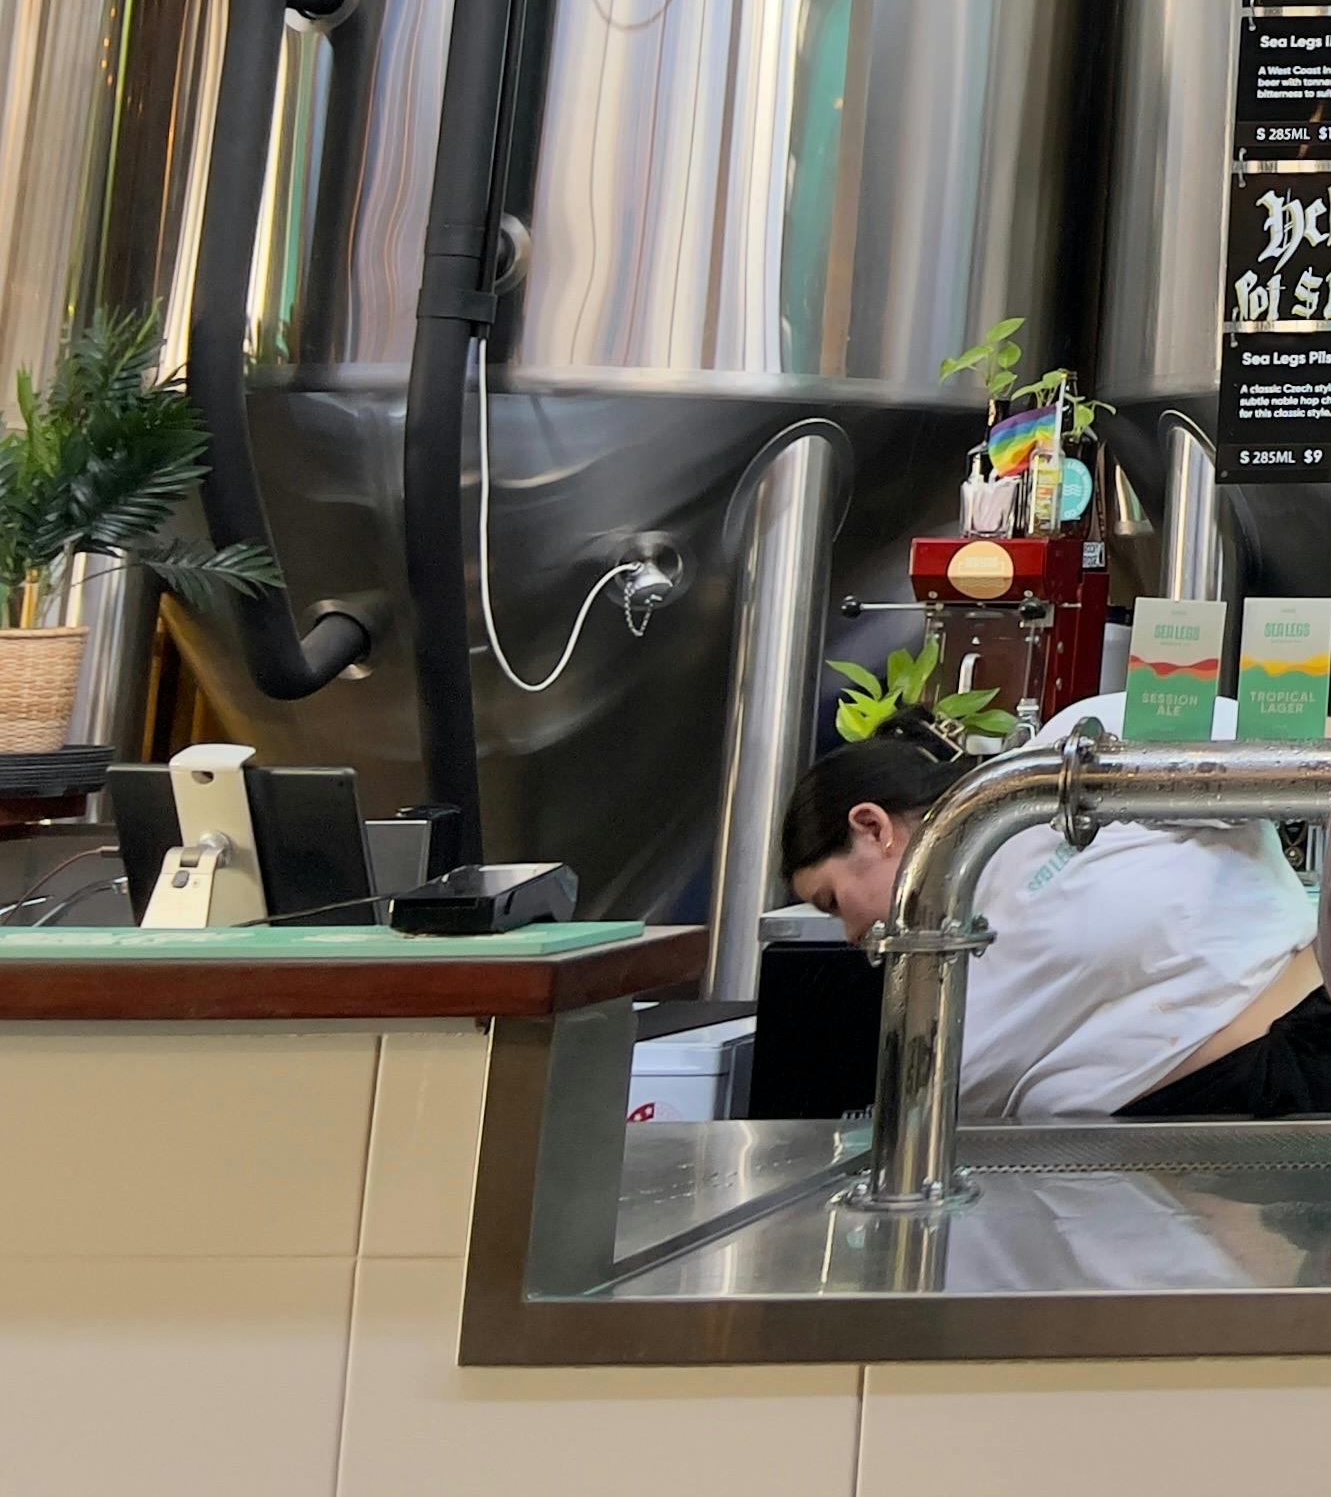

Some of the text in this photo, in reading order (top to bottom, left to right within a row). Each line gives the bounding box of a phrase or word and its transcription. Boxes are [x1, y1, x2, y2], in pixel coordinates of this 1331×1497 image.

[1261, 36, 1286, 48] Sea
[1290, 36, 1322, 50] Legs
[1256, 128, 1265, 140] S
[1268, 127, 1311, 140] 285ML
[1242, 352, 1270, 365] Sea
[1274, 352, 1306, 368] Legs
[1142, 693, 1198, 705] SESSION
[1250, 691, 1316, 702] TROPICAL
[1156, 705, 1181, 716] ALE
[1260, 703, 1304, 714] LAGER
